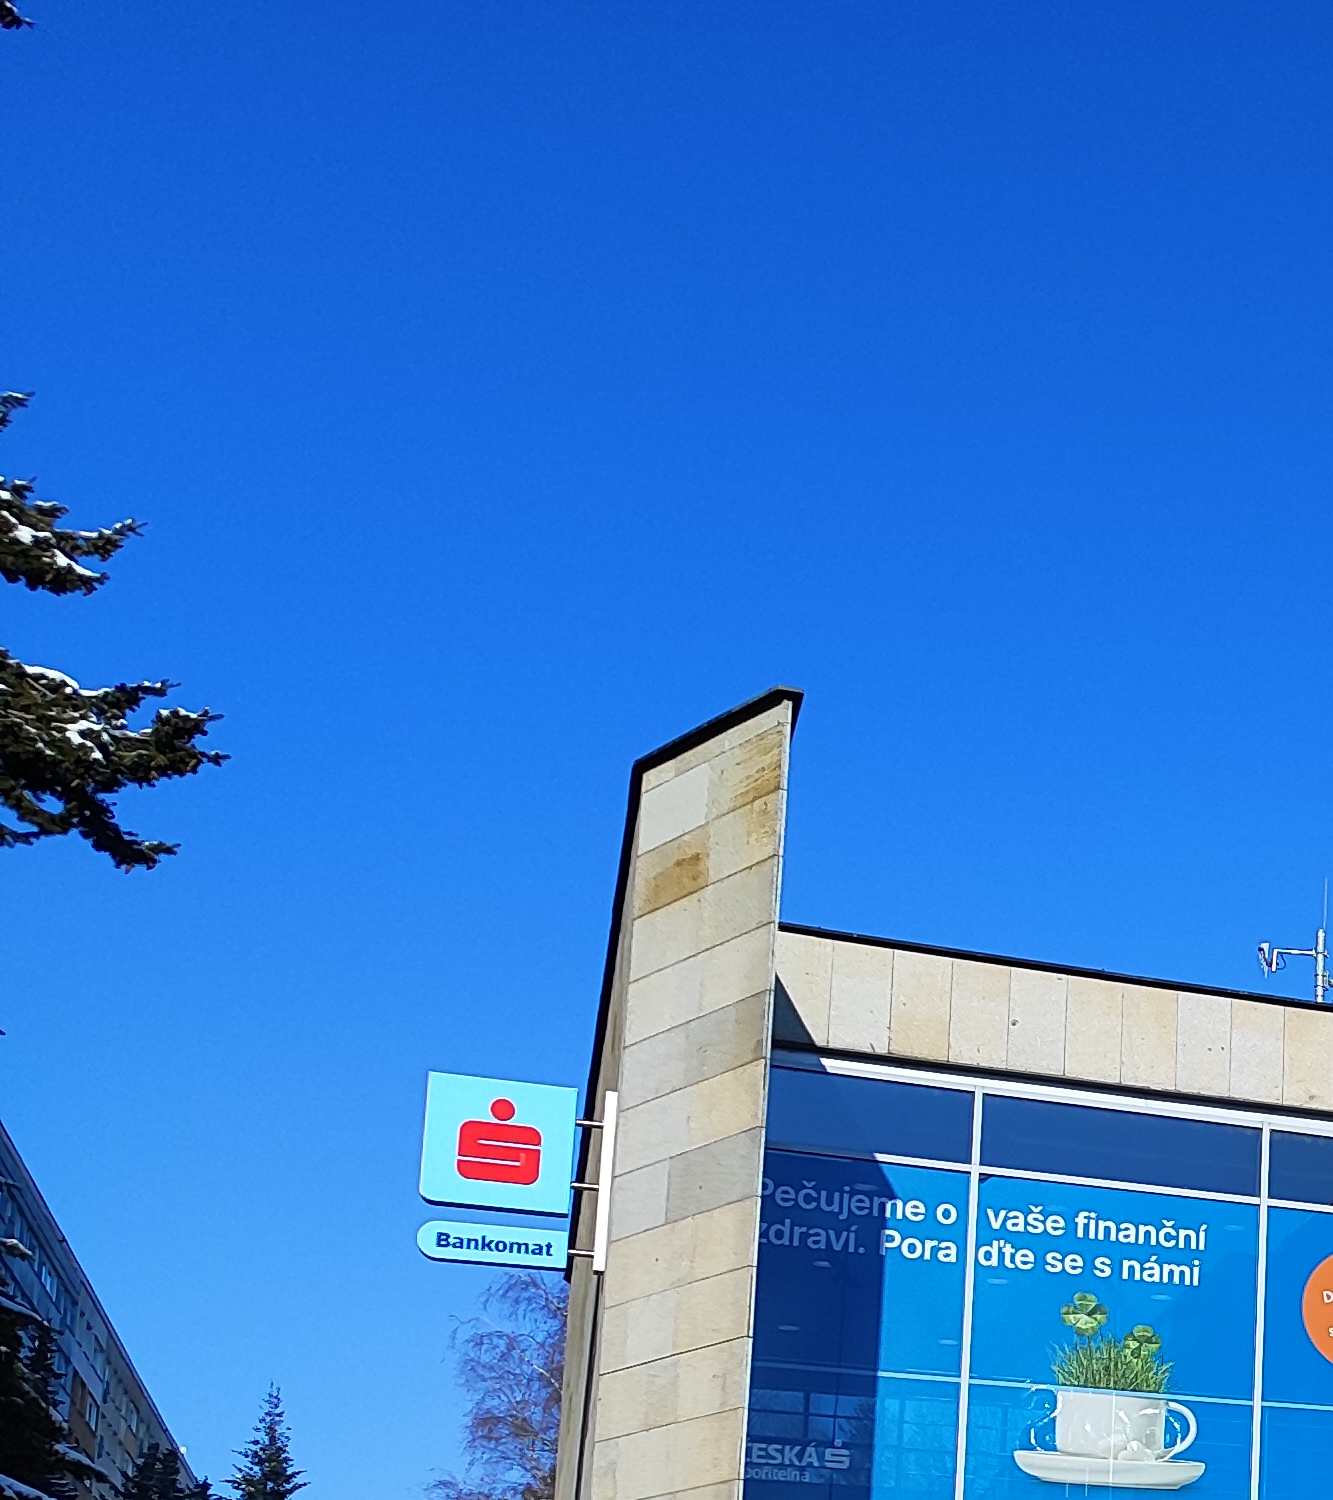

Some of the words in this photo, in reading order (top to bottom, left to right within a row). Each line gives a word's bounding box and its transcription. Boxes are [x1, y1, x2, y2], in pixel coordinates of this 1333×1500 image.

[935, 1202, 959, 1225] o
[986, 1204, 1067, 1236] vaše
[1074, 1210, 1208, 1251] finanční
[435, 1231, 555, 1257] Bankomat
[1044, 1250, 1084, 1276] se
[1092, 1255, 1113, 1279] s
[1121, 1254, 1202, 1287] námi
[747, 1441, 821, 1467] ESKÁ
